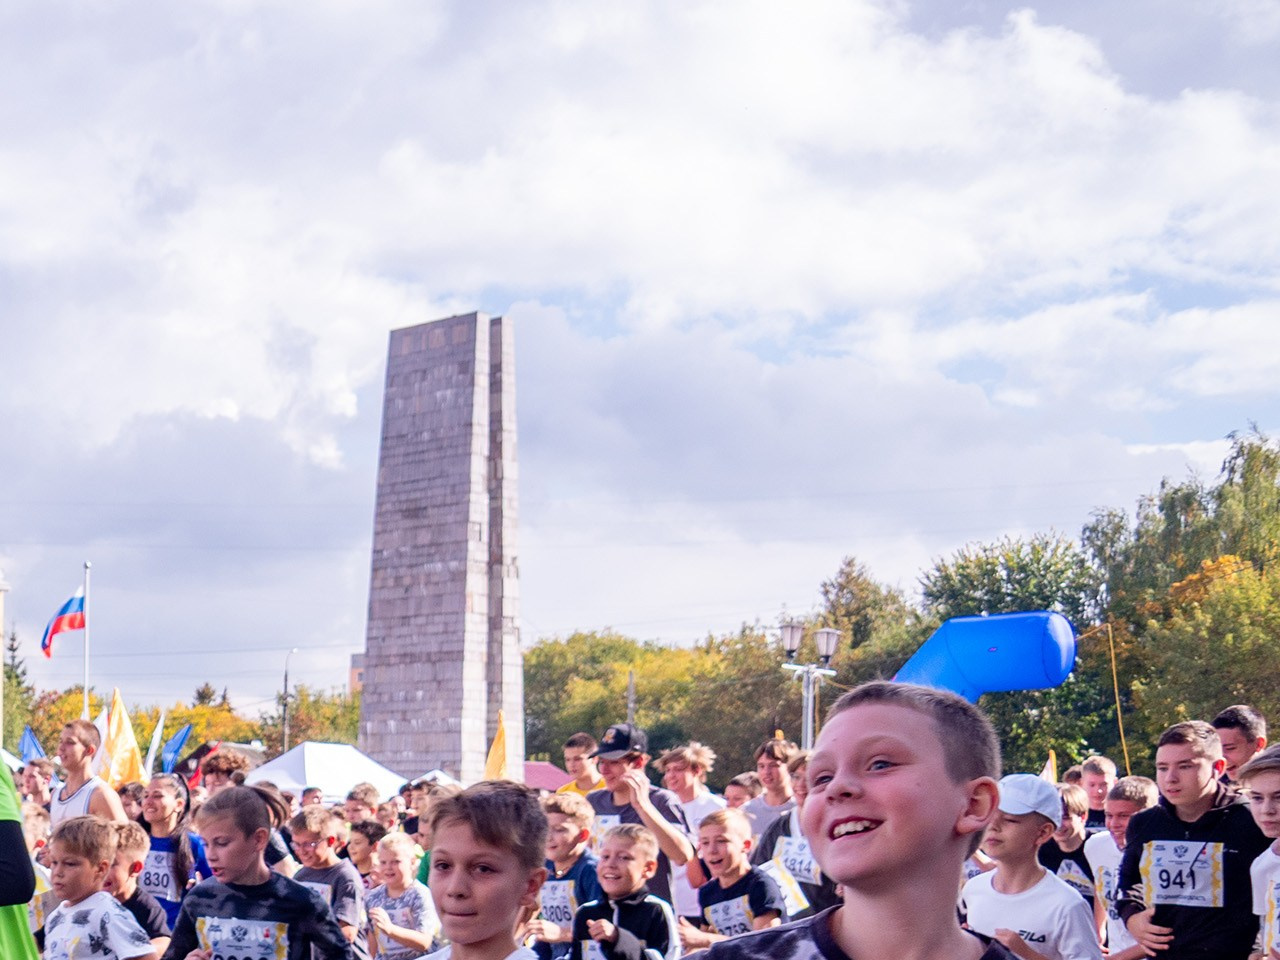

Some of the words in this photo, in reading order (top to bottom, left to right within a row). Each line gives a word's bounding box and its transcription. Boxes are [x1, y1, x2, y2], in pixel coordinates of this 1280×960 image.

[143, 871, 170, 888] 830
[1158, 868, 1196, 890] 941
[1018, 929, 1046, 943] FILA
